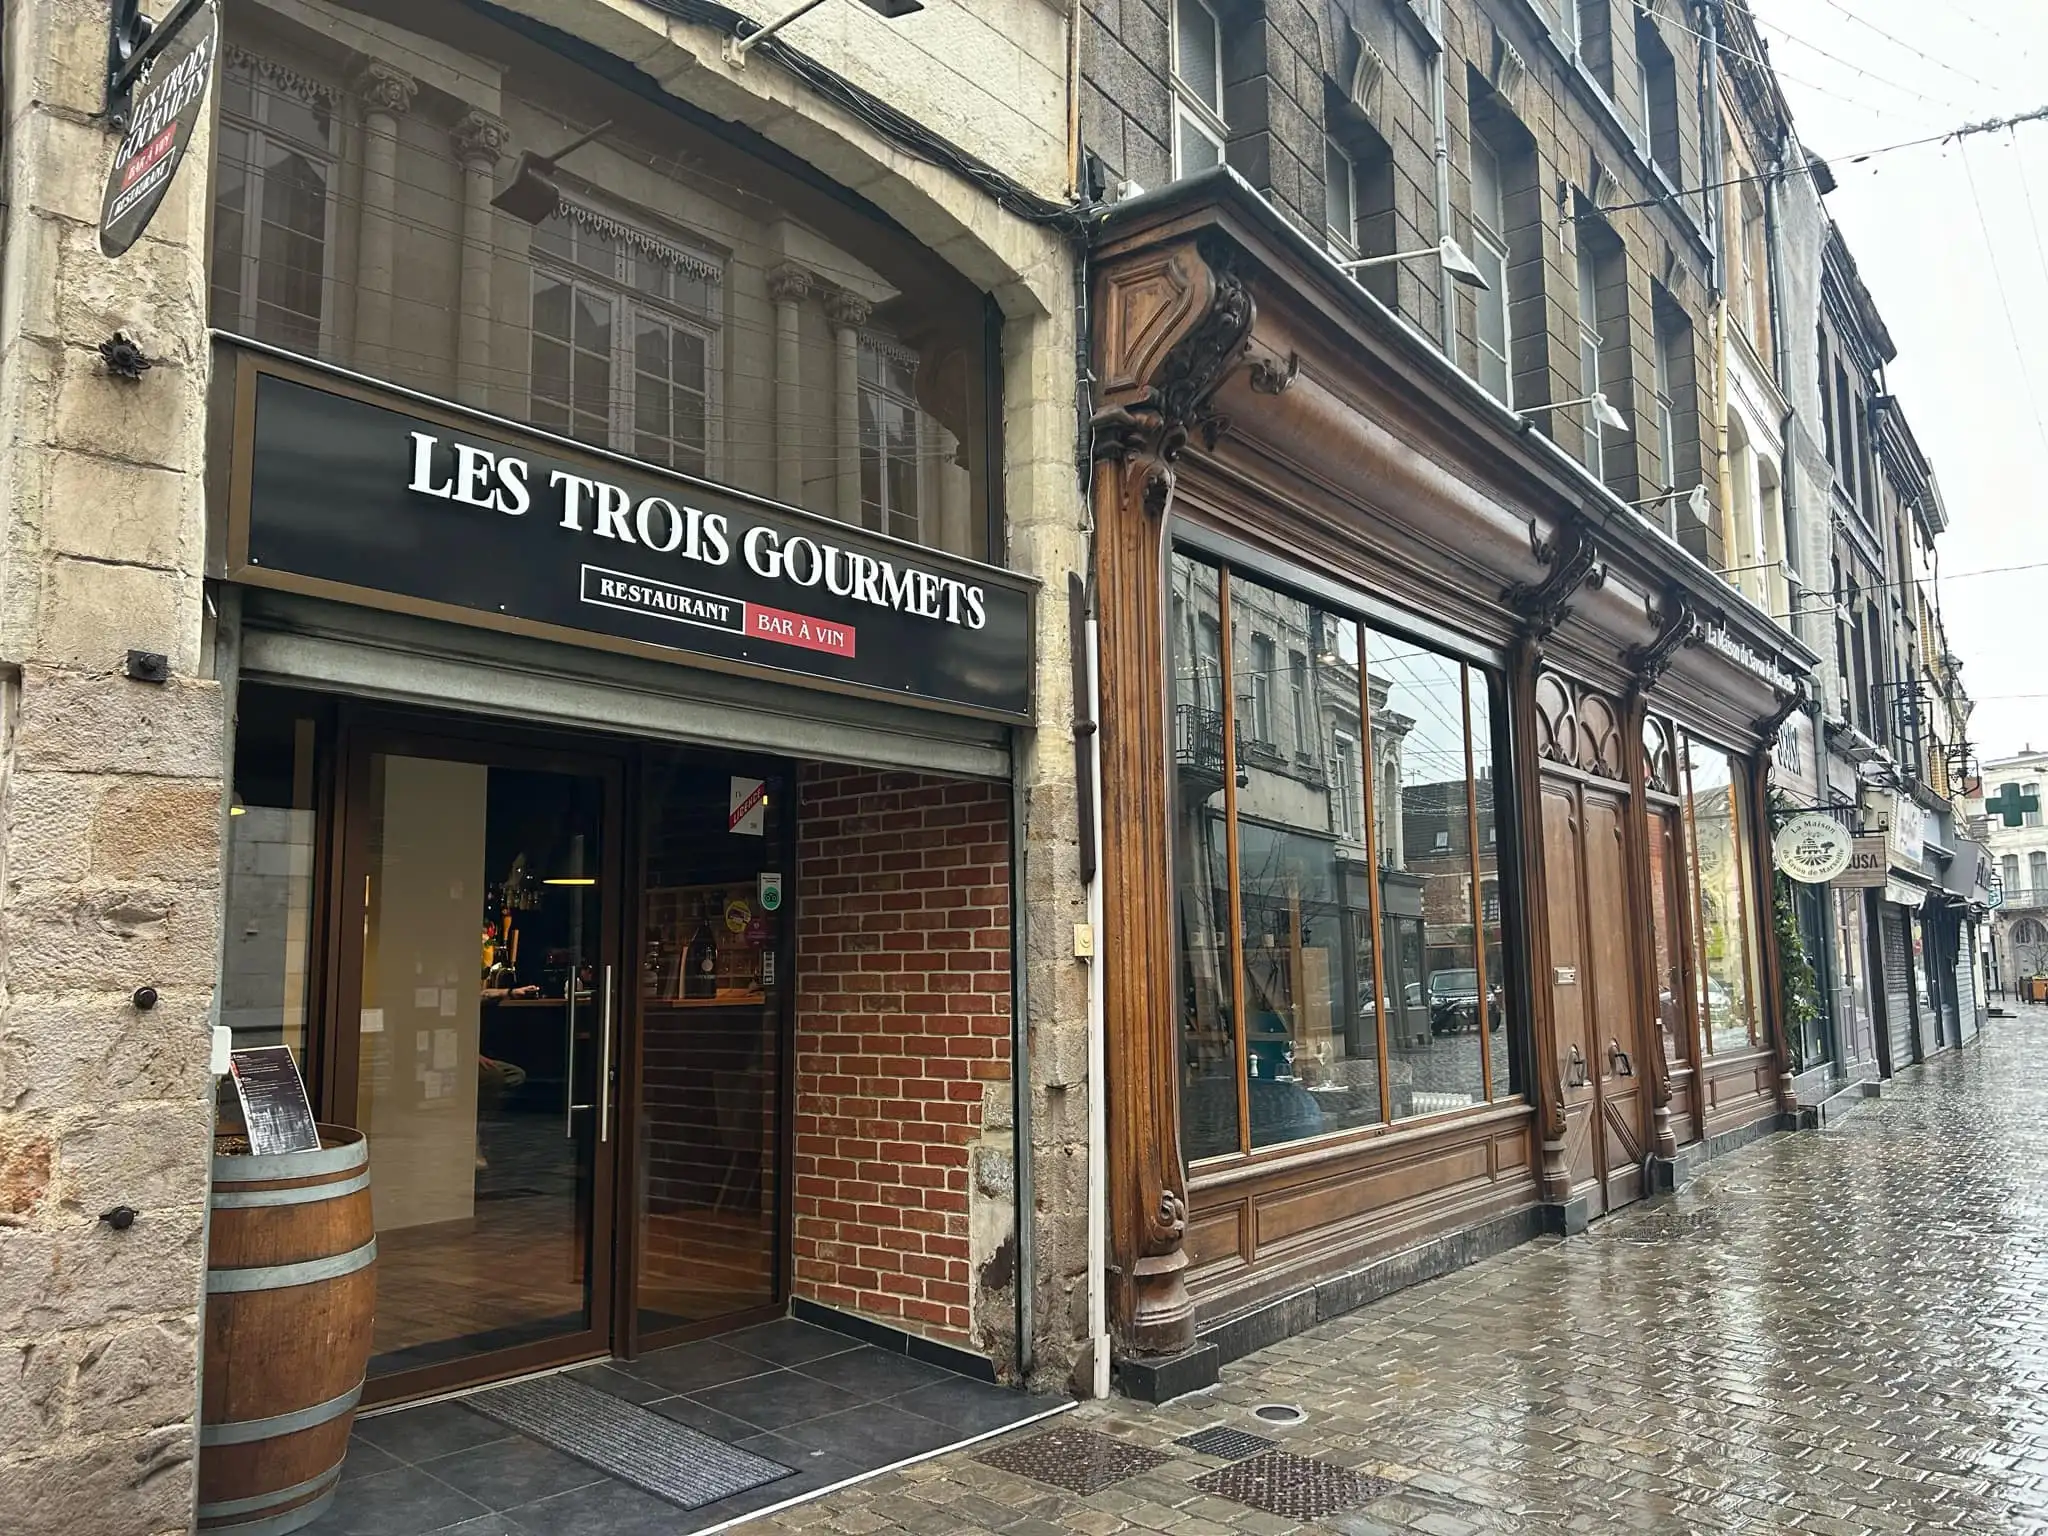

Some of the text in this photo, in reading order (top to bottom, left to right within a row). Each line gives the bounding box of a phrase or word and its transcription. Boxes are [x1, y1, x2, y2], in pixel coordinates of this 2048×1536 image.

[129, 35, 209, 135] LES TROIS
[115, 62, 208, 170] GOURMETS
[114, 160, 167, 212] RESTAURANT
[408, 431, 986, 630] LES TROIS GOURMETS
[600, 578, 844, 648] RESTAURANT BAR À VIN
[1705, 621, 1717, 647] La
[1716, 620, 1740, 660] Maison
[1791, 820, 1836, 834] La Maison
[1818, 848, 1845, 873] Marseille
